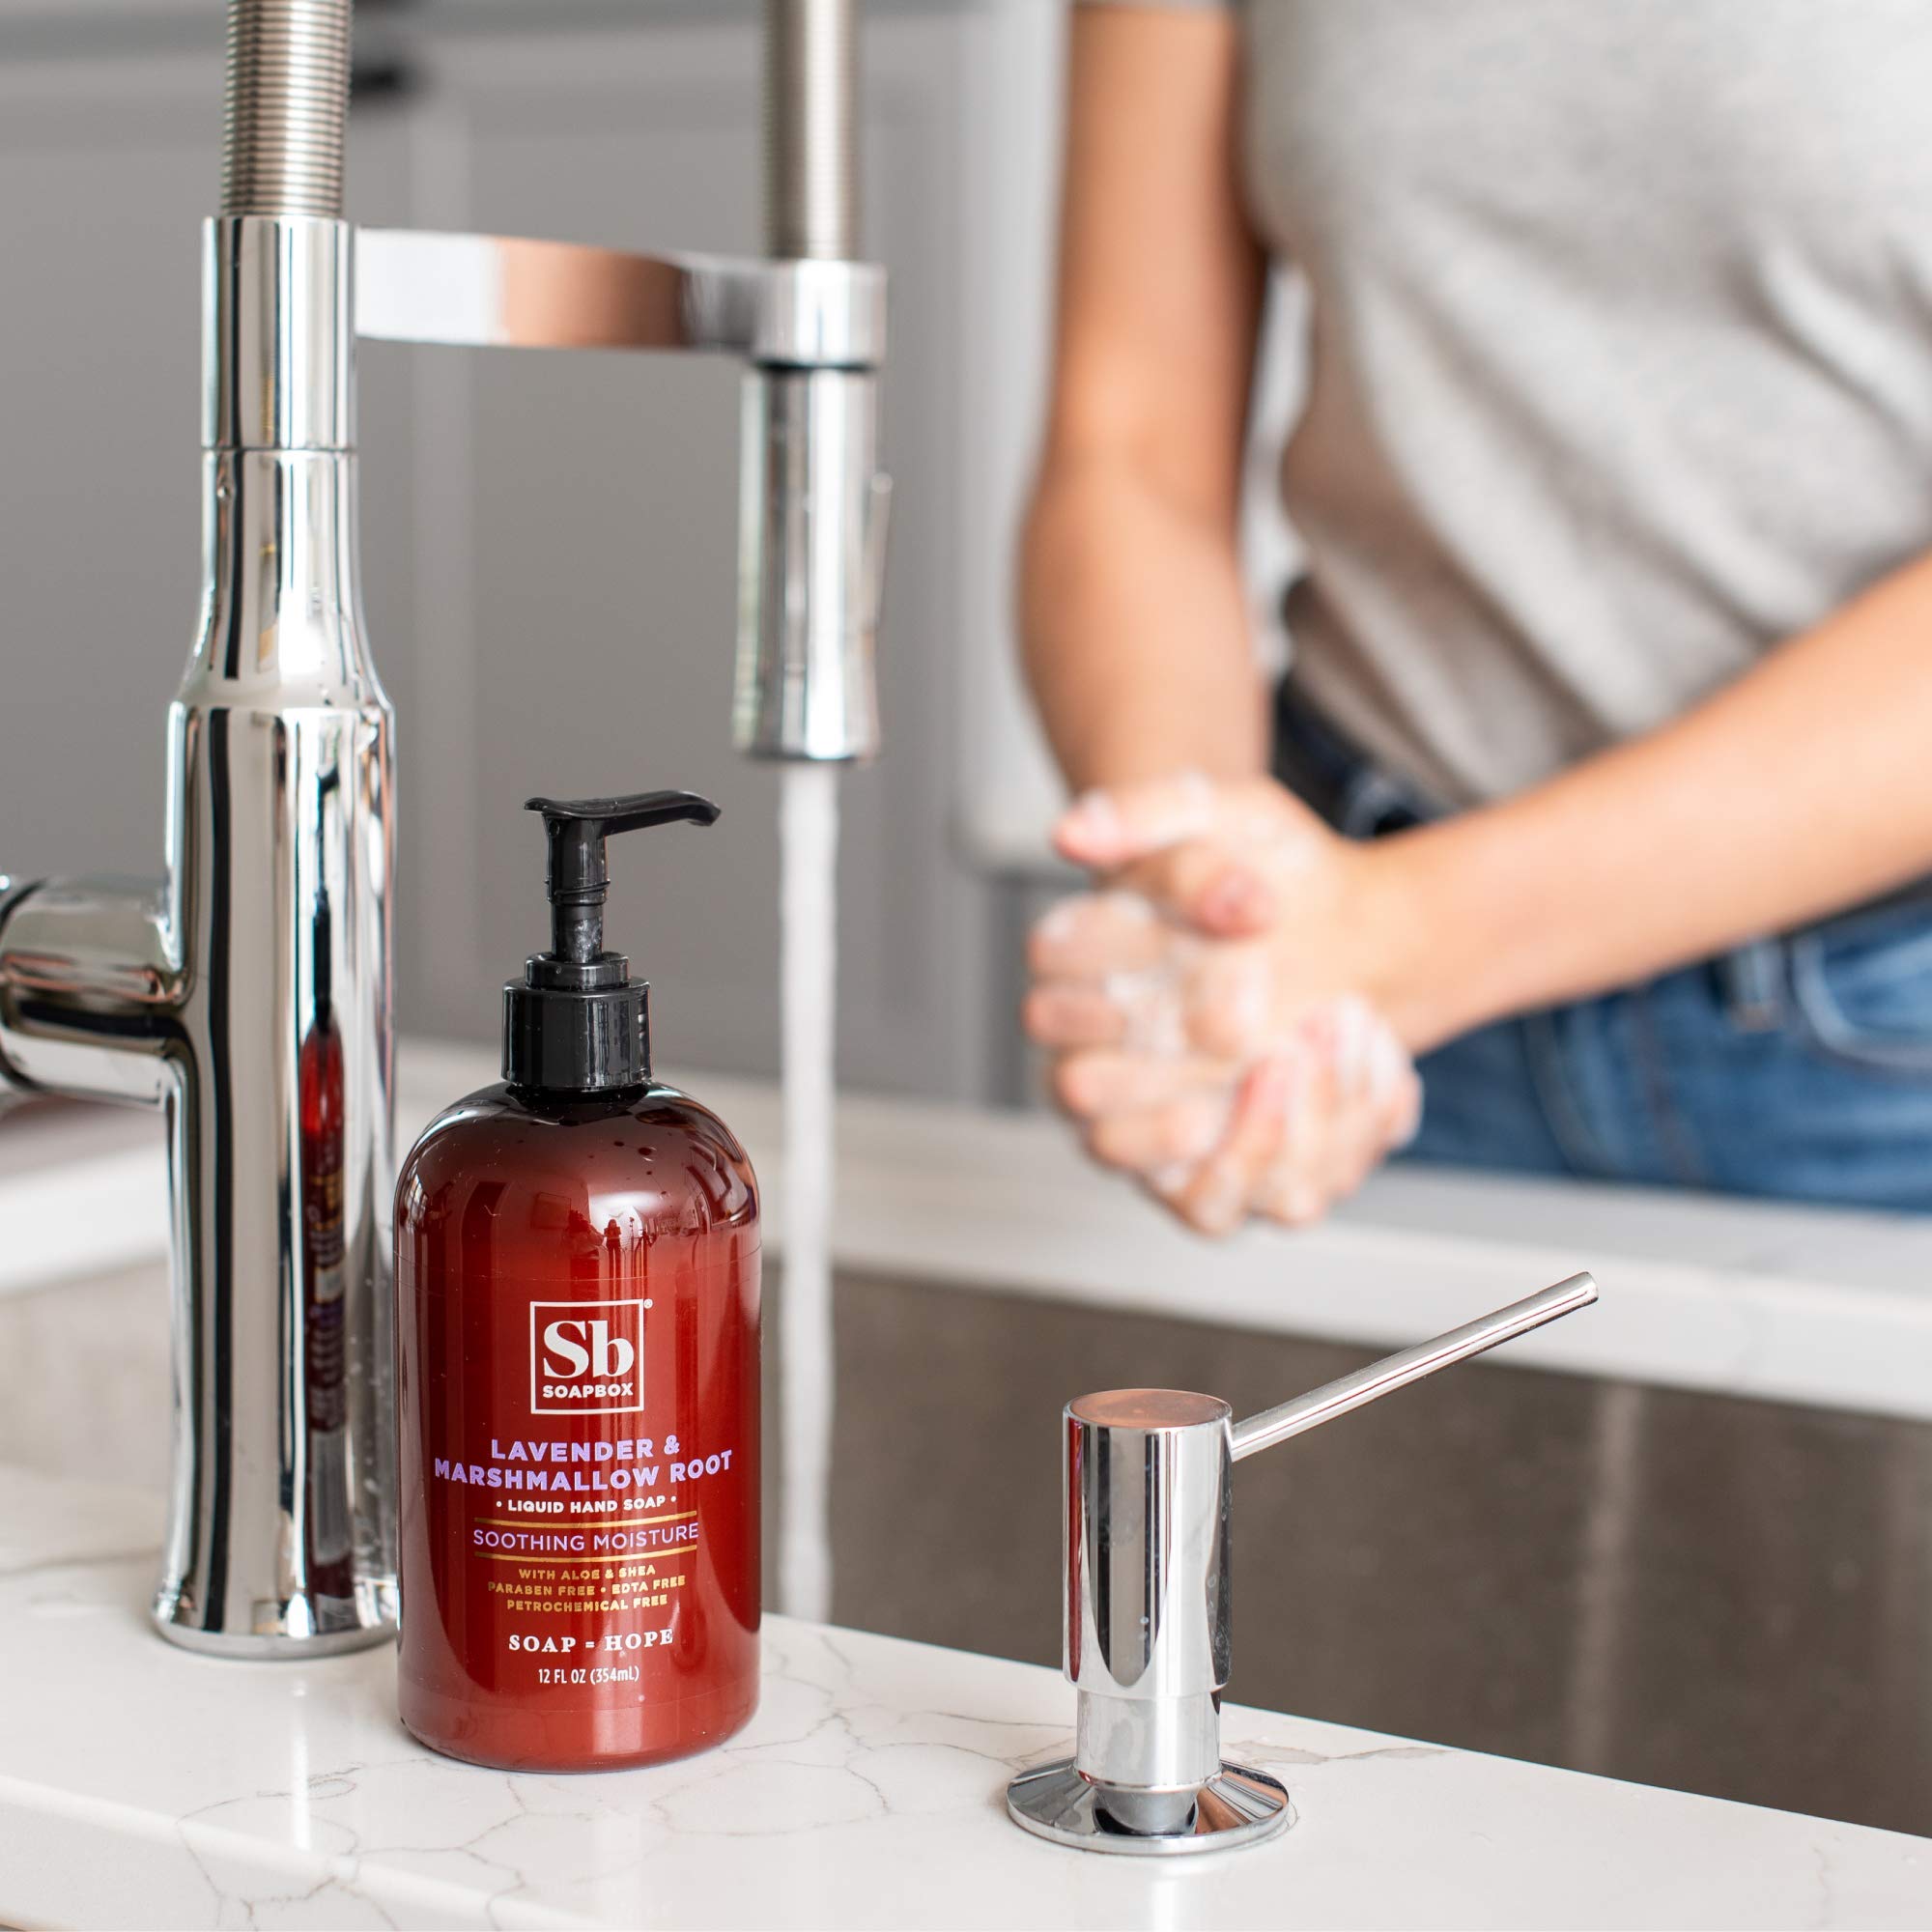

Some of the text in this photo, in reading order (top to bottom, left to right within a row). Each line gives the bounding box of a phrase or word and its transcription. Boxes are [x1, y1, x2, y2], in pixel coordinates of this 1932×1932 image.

[543, 1320, 635, 1378] Sb
[542, 1382, 634, 1399] SOAPBOX
[491, 1435, 680, 1463] LAVENDER &
[435, 1450, 732, 1492] MARSHMALLOW ROOT
[507, 1495, 666, 1515] LIQUID HAND SOAP
[473, 1522, 699, 1551] SOOTHING MOISTURE
[519, 1565, 656, 1581] WITH ALOE & SHEA
[488, 1576, 686, 1597] PARABEN FREE EDTA FREE
[507, 1595, 668, 1612] PETROCHEMICAL FREE
[508, 1634, 577, 1653] SOAP
[604, 1629, 673, 1652] HOPE
[538, 1666, 639, 1685] 12 FL OZ (354mL)
